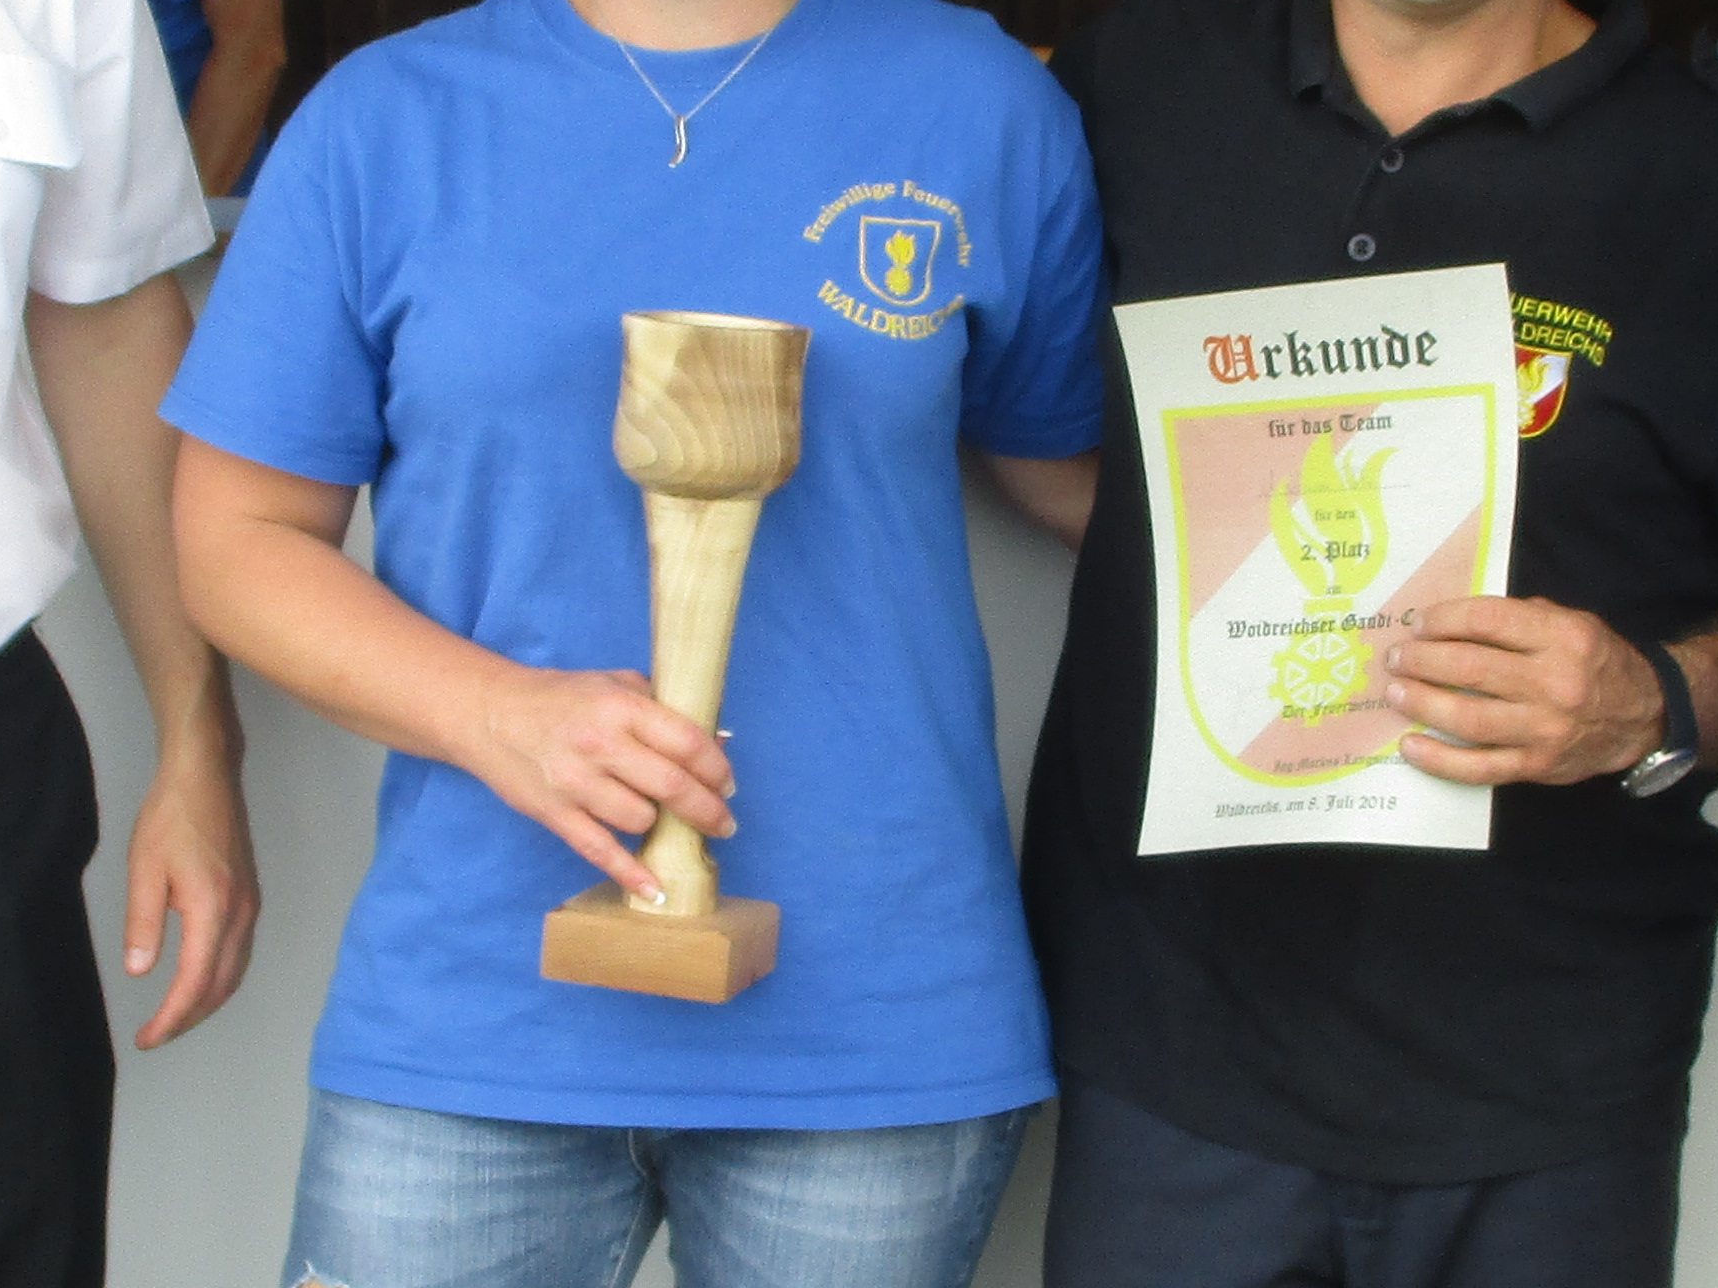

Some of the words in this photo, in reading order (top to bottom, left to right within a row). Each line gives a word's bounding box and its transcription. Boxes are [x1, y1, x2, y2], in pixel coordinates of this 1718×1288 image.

[1202, 323, 1440, 385] Urkunde
[1268, 419, 1296, 438] für
[1301, 418, 1333, 435] das
[1338, 413, 1393, 432] Team
[1300, 544, 1317, 561] 2.
[1324, 539, 1371, 562] Platz
[1324, 794, 1354, 813] Juli
[1357, 795, 1399, 811] 2018
